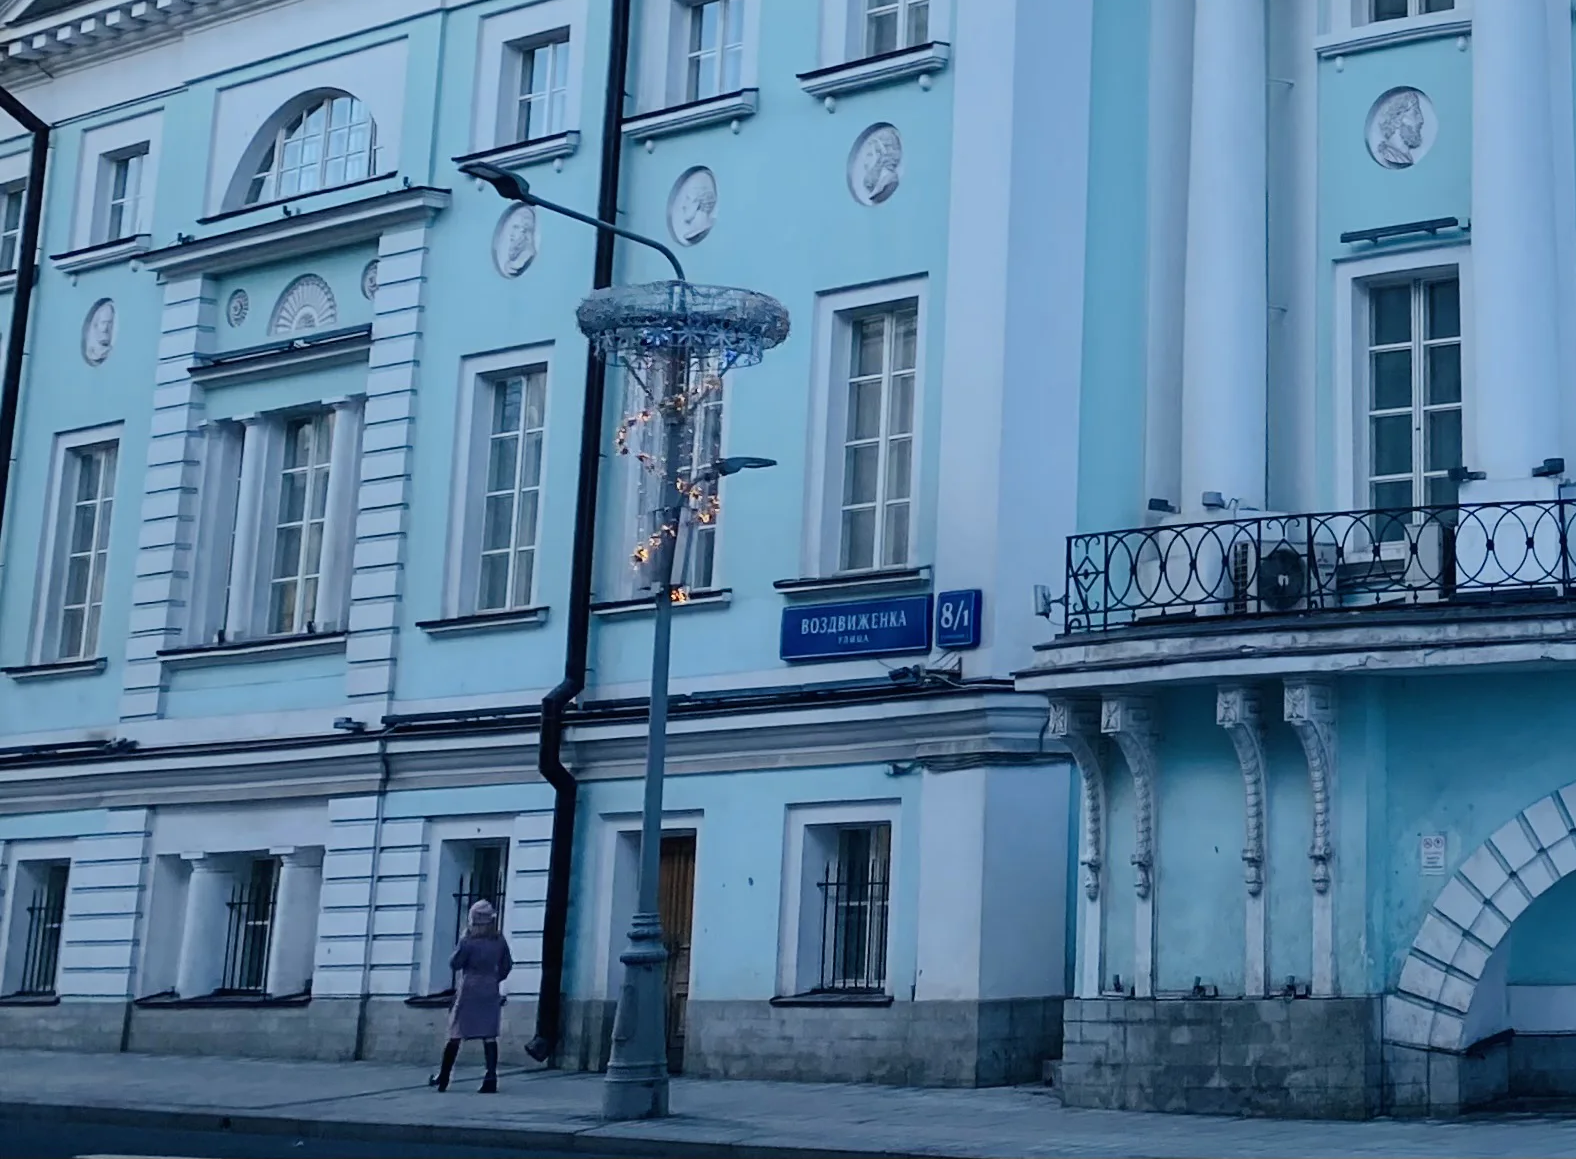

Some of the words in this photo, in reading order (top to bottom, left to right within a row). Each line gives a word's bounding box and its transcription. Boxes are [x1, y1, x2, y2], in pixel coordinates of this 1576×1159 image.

[800, 610, 907, 635] ВОЗДВИЖЕНКА
[940, 599, 969, 631] 8/1
[838, 635, 869, 645] УЛИЦА
